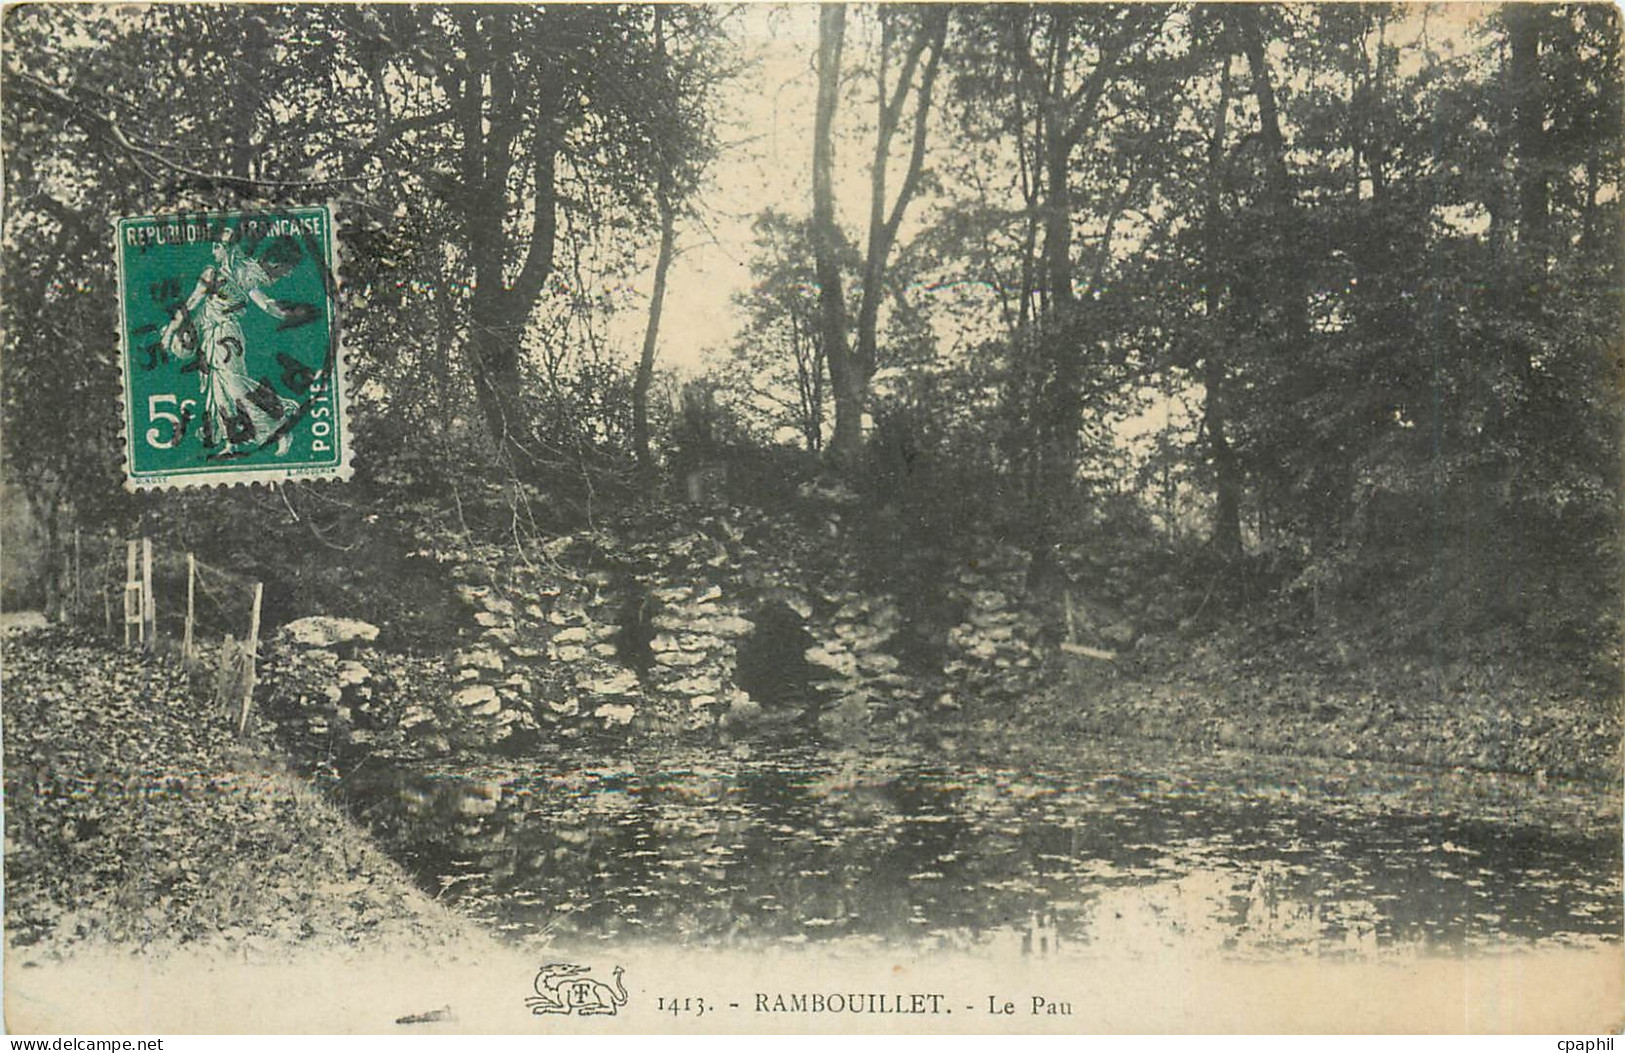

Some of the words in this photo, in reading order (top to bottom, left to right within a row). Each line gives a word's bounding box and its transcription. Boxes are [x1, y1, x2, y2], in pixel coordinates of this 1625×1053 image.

[657, 997, 716, 1017] 1413.
[755, 993, 953, 1014] RAMBOUILLET.
[988, 995, 1015, 1015] Le
[1031, 996, 1072, 1015] Pau
